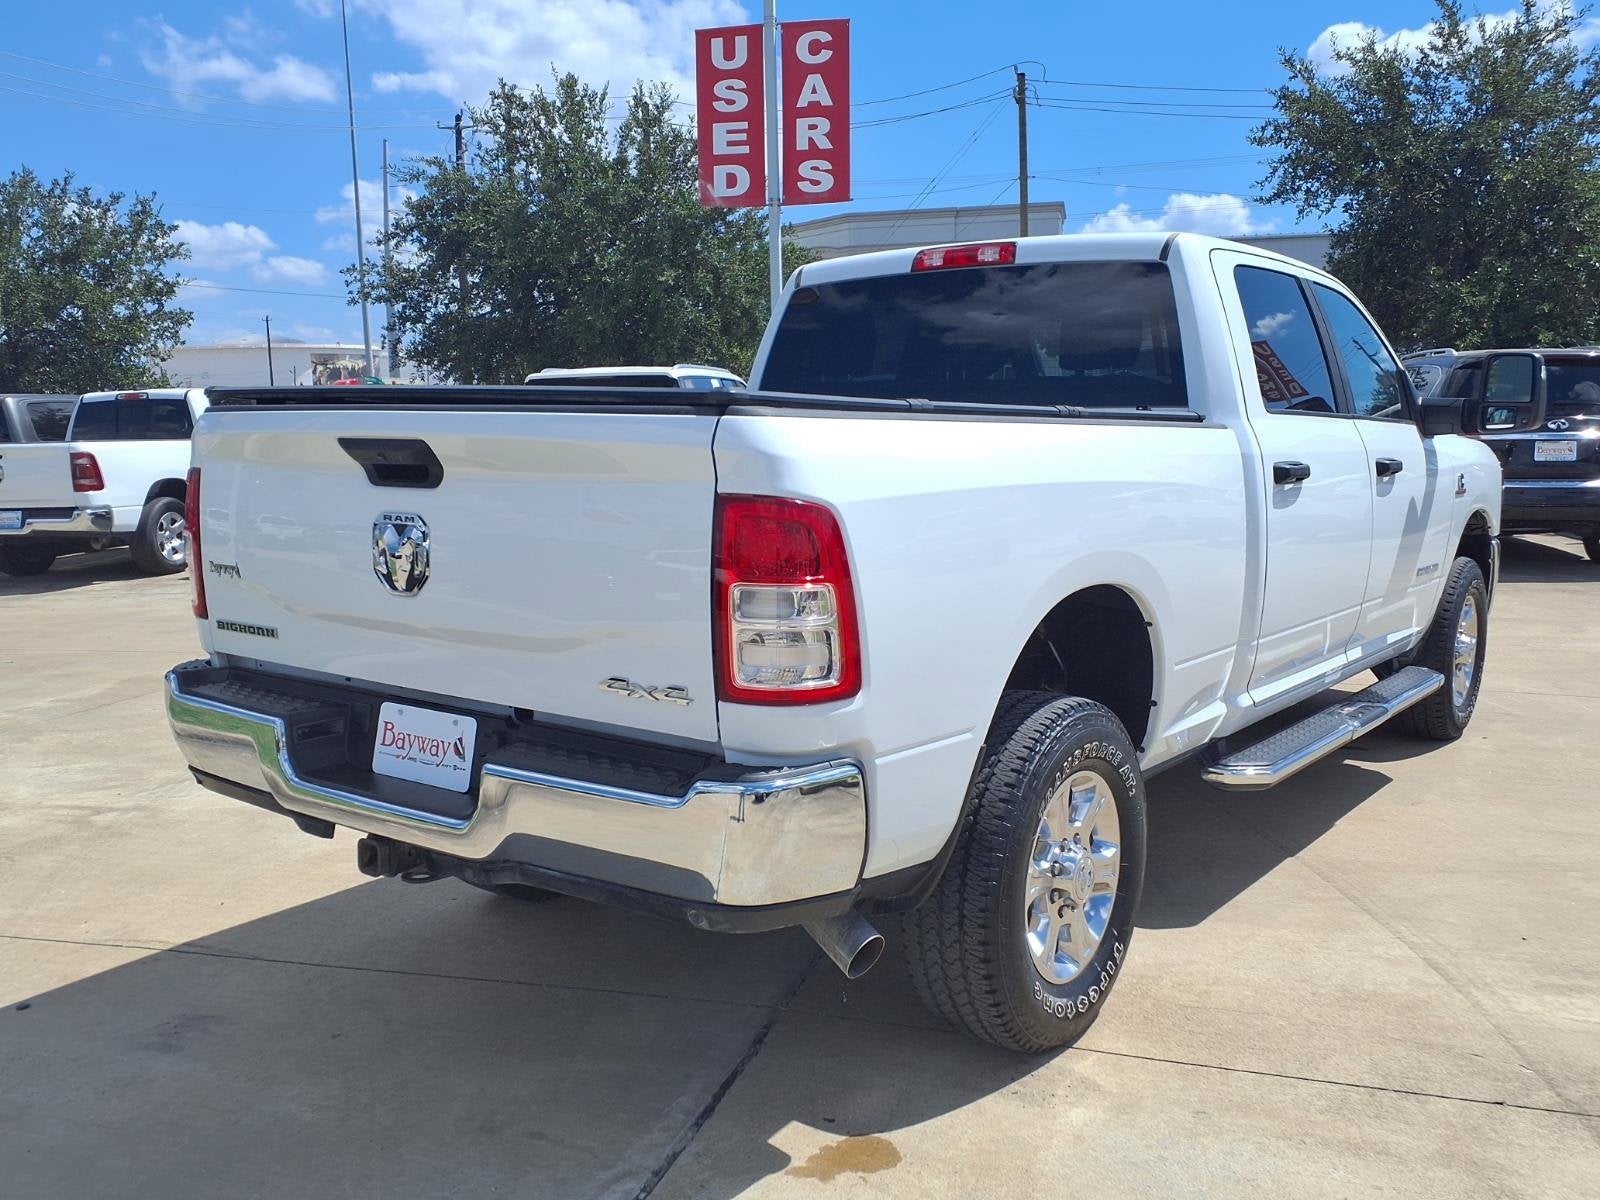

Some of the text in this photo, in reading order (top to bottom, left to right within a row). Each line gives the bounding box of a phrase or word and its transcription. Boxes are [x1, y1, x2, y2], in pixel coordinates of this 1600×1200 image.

[711, 35, 751, 197] USED
[795, 30, 835, 193] CARS
[383, 514, 415, 523] RAM
[216, 620, 279, 639] BIGHORN
[380, 720, 451, 767] Bayway
